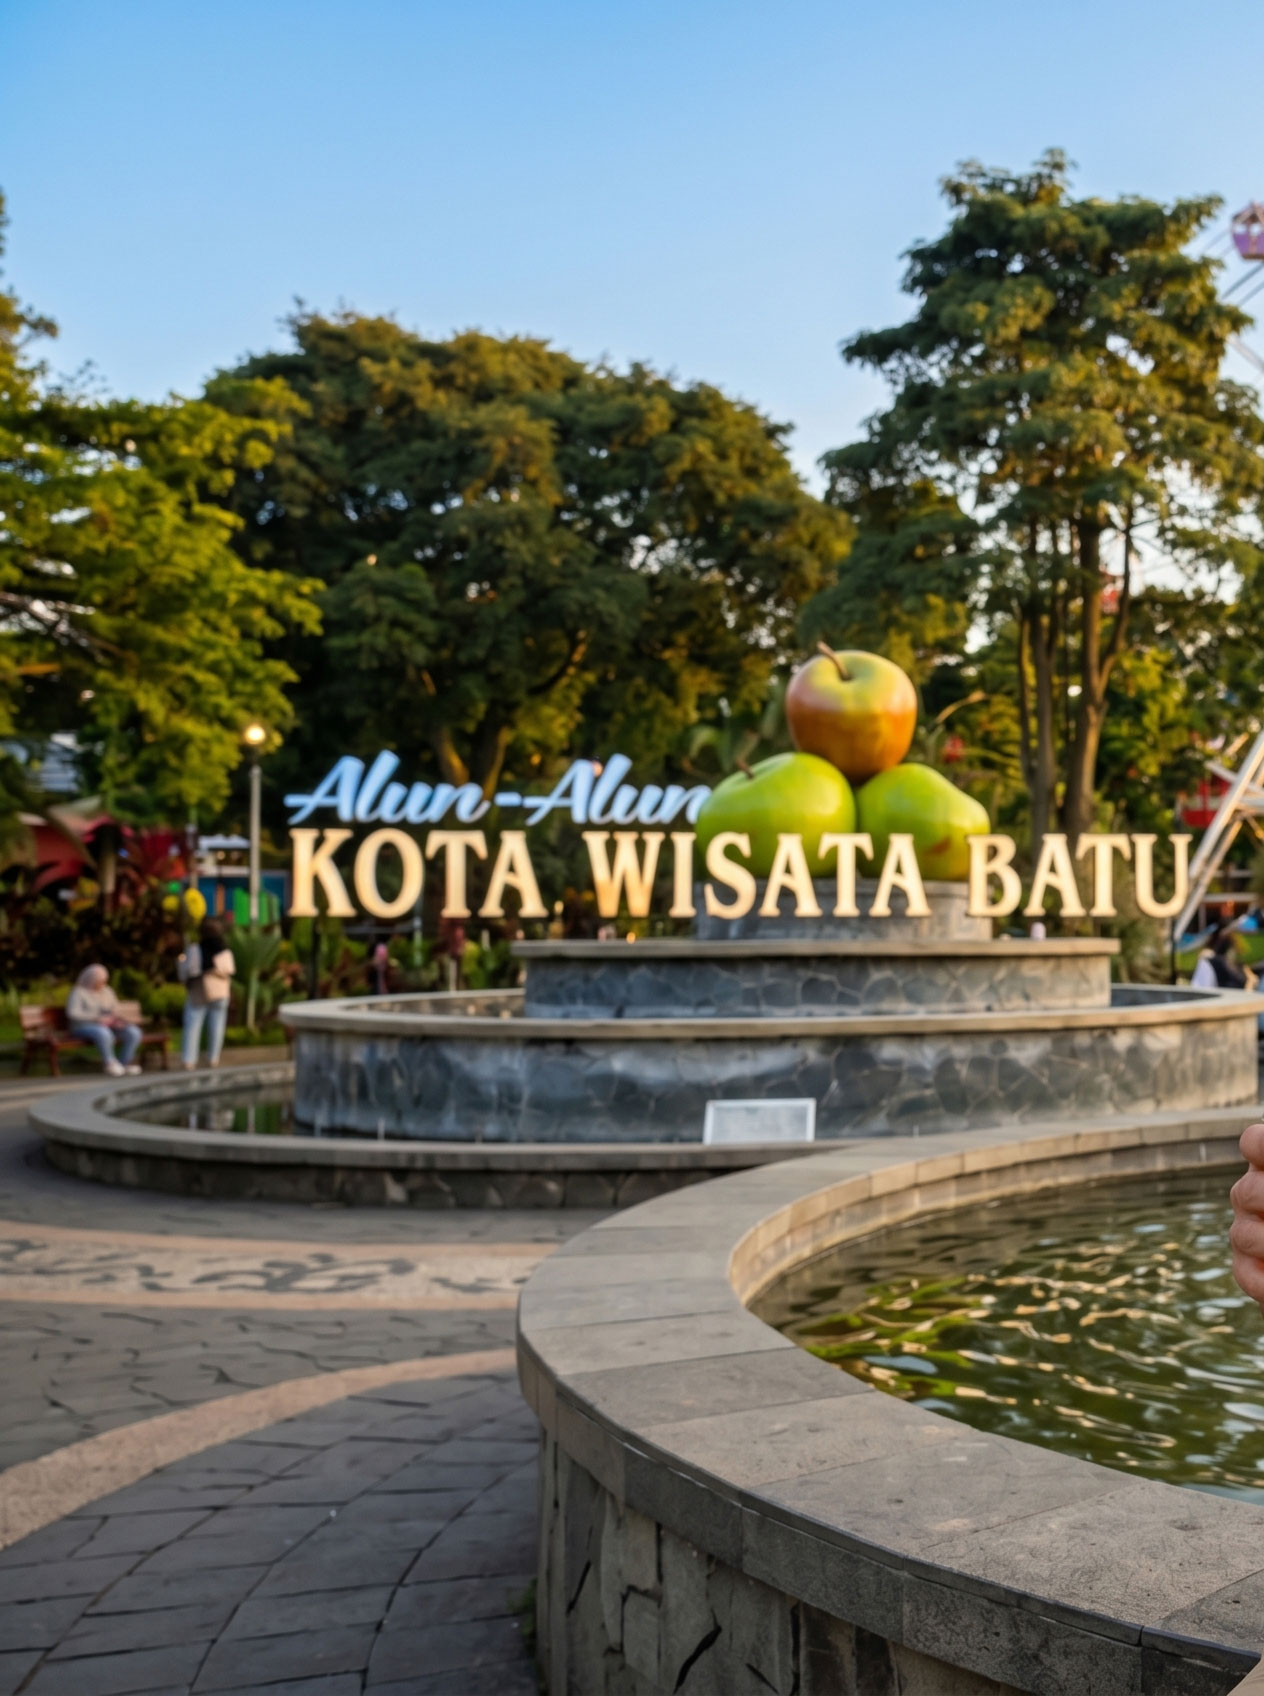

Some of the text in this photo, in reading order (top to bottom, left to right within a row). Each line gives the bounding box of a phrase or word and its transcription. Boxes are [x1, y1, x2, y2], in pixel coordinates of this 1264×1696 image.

[284, 749, 711, 827] Alun-Alun
[288, 827, 1193, 919] KOTA WISATA BATU
